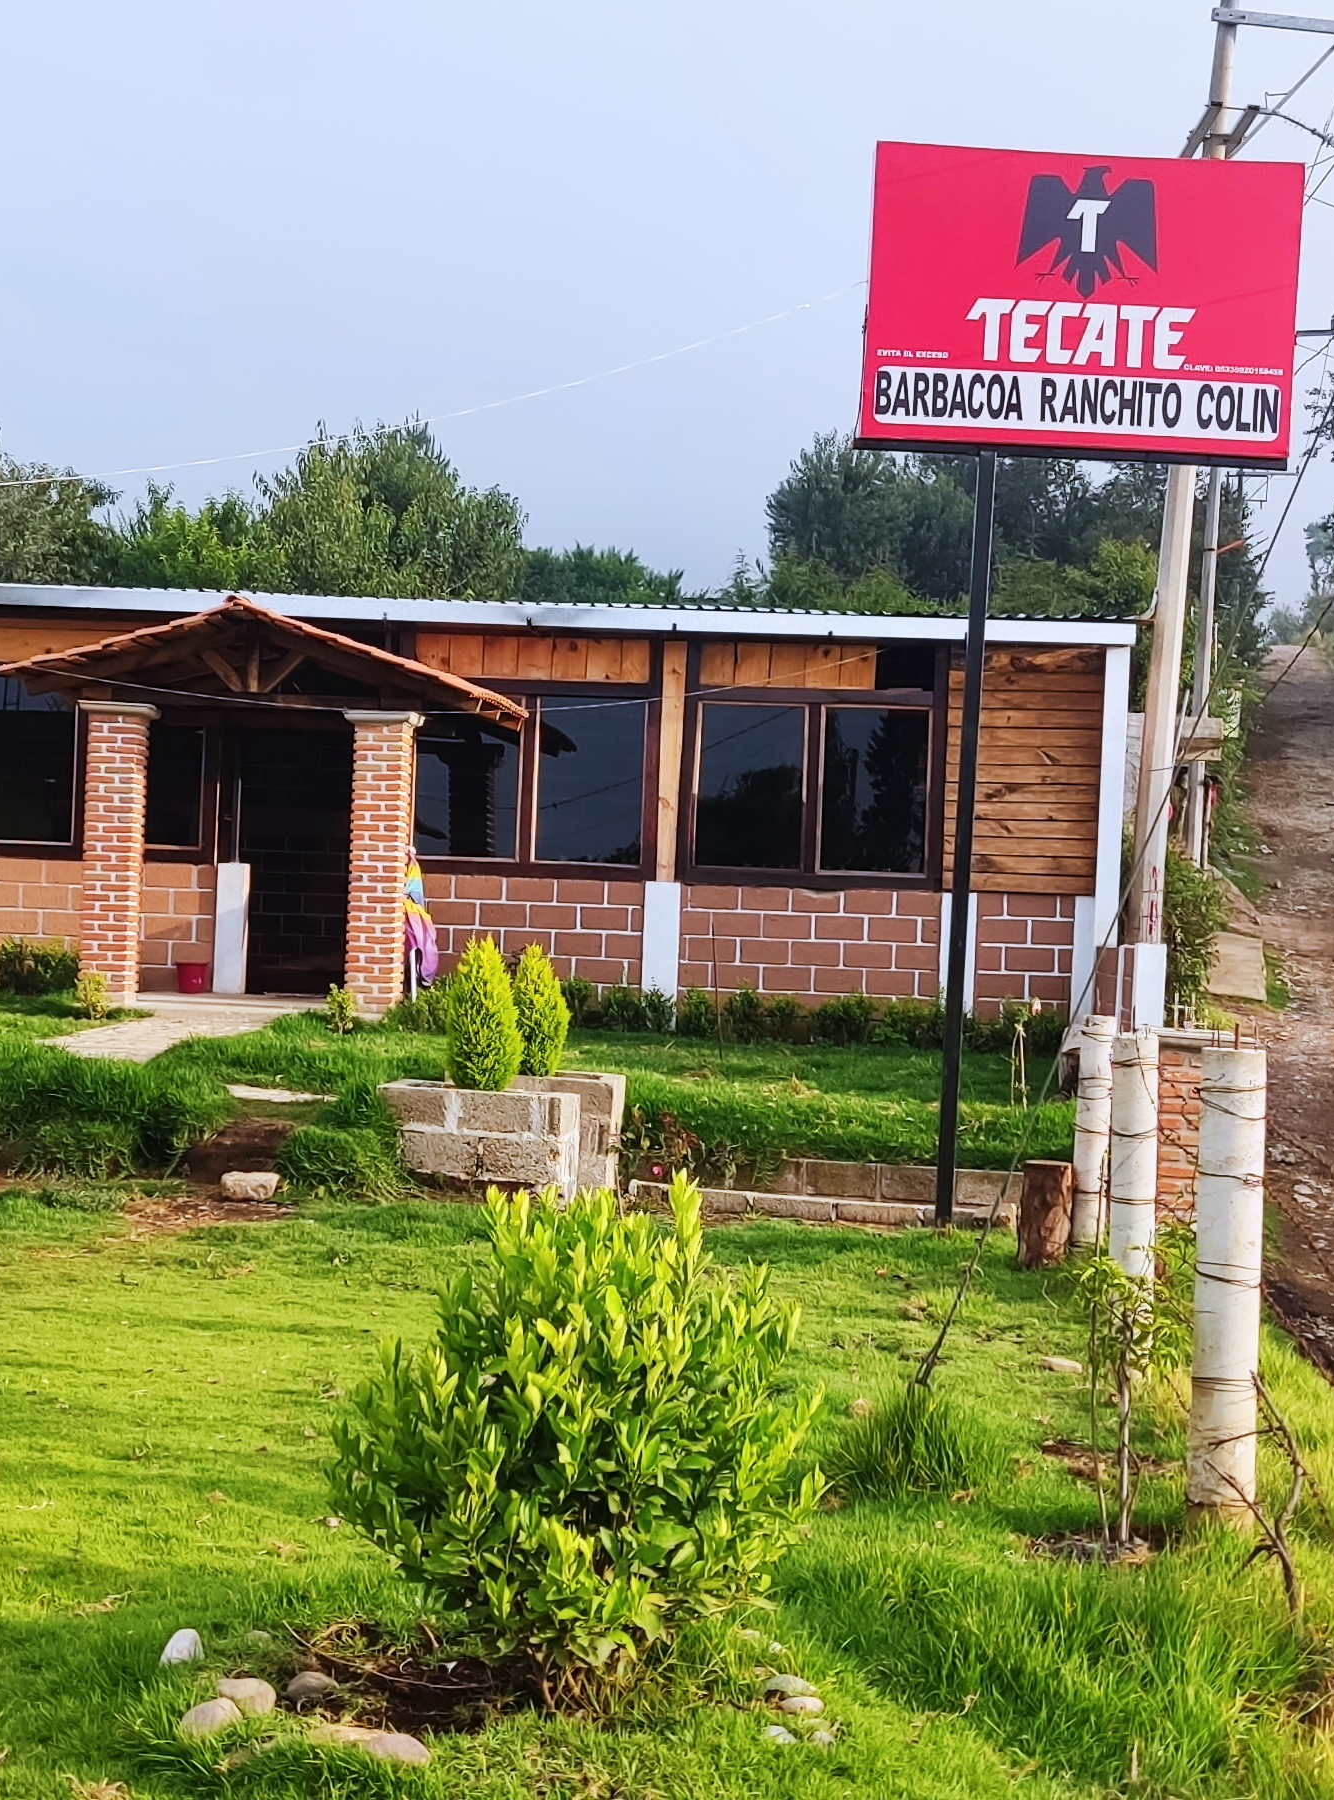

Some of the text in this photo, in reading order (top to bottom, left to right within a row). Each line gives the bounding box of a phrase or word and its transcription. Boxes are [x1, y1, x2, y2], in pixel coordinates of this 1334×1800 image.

[1066, 199, 1111, 253] T
[876, 348, 902, 358] EVITA
[965, 298, 1197, 370] TECATE
[875, 371, 1279, 433] BARBACOA RANCHITO COLIN
